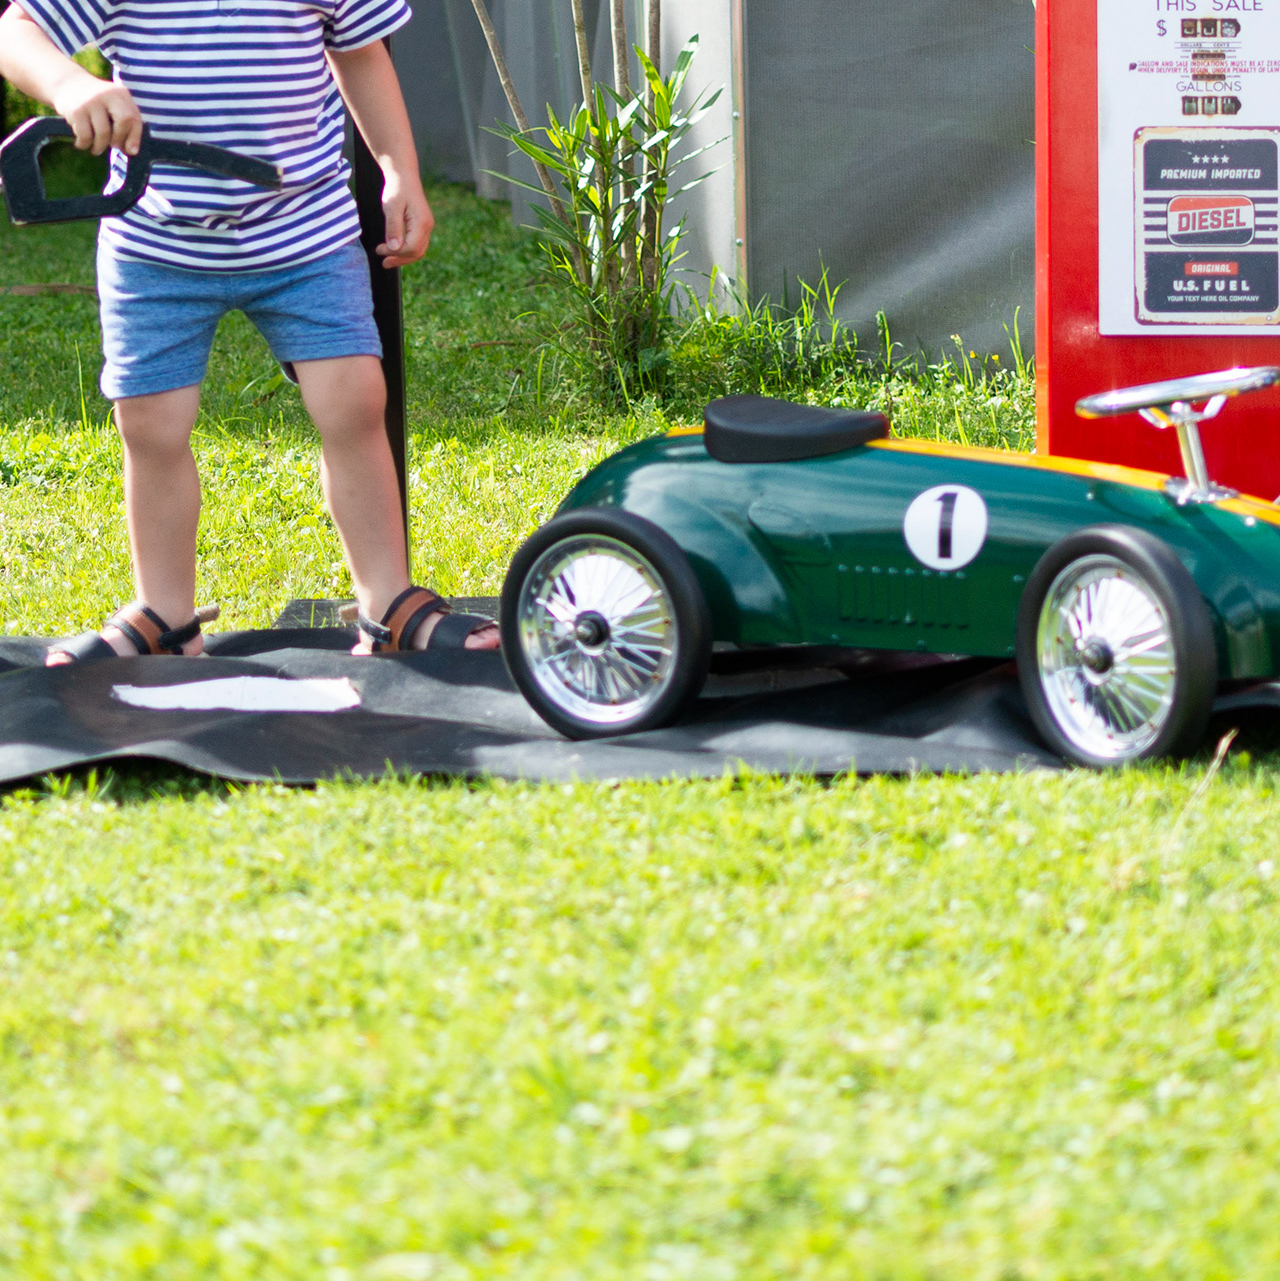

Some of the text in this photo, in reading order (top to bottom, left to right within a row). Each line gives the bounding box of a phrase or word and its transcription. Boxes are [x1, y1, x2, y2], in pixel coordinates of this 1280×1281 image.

[1156, 19, 1167, 36] $
[1176, 80, 1242, 92] GALLONS
[1160, 169, 1261, 179] PREMIUM IMPORTED
[1177, 208, 1247, 232] DIESEL
[1191, 264, 1231, 273] ORIGINAL
[1172, 280, 1250, 291] U.S. FUEL
[935, 491, 959, 559] 1
